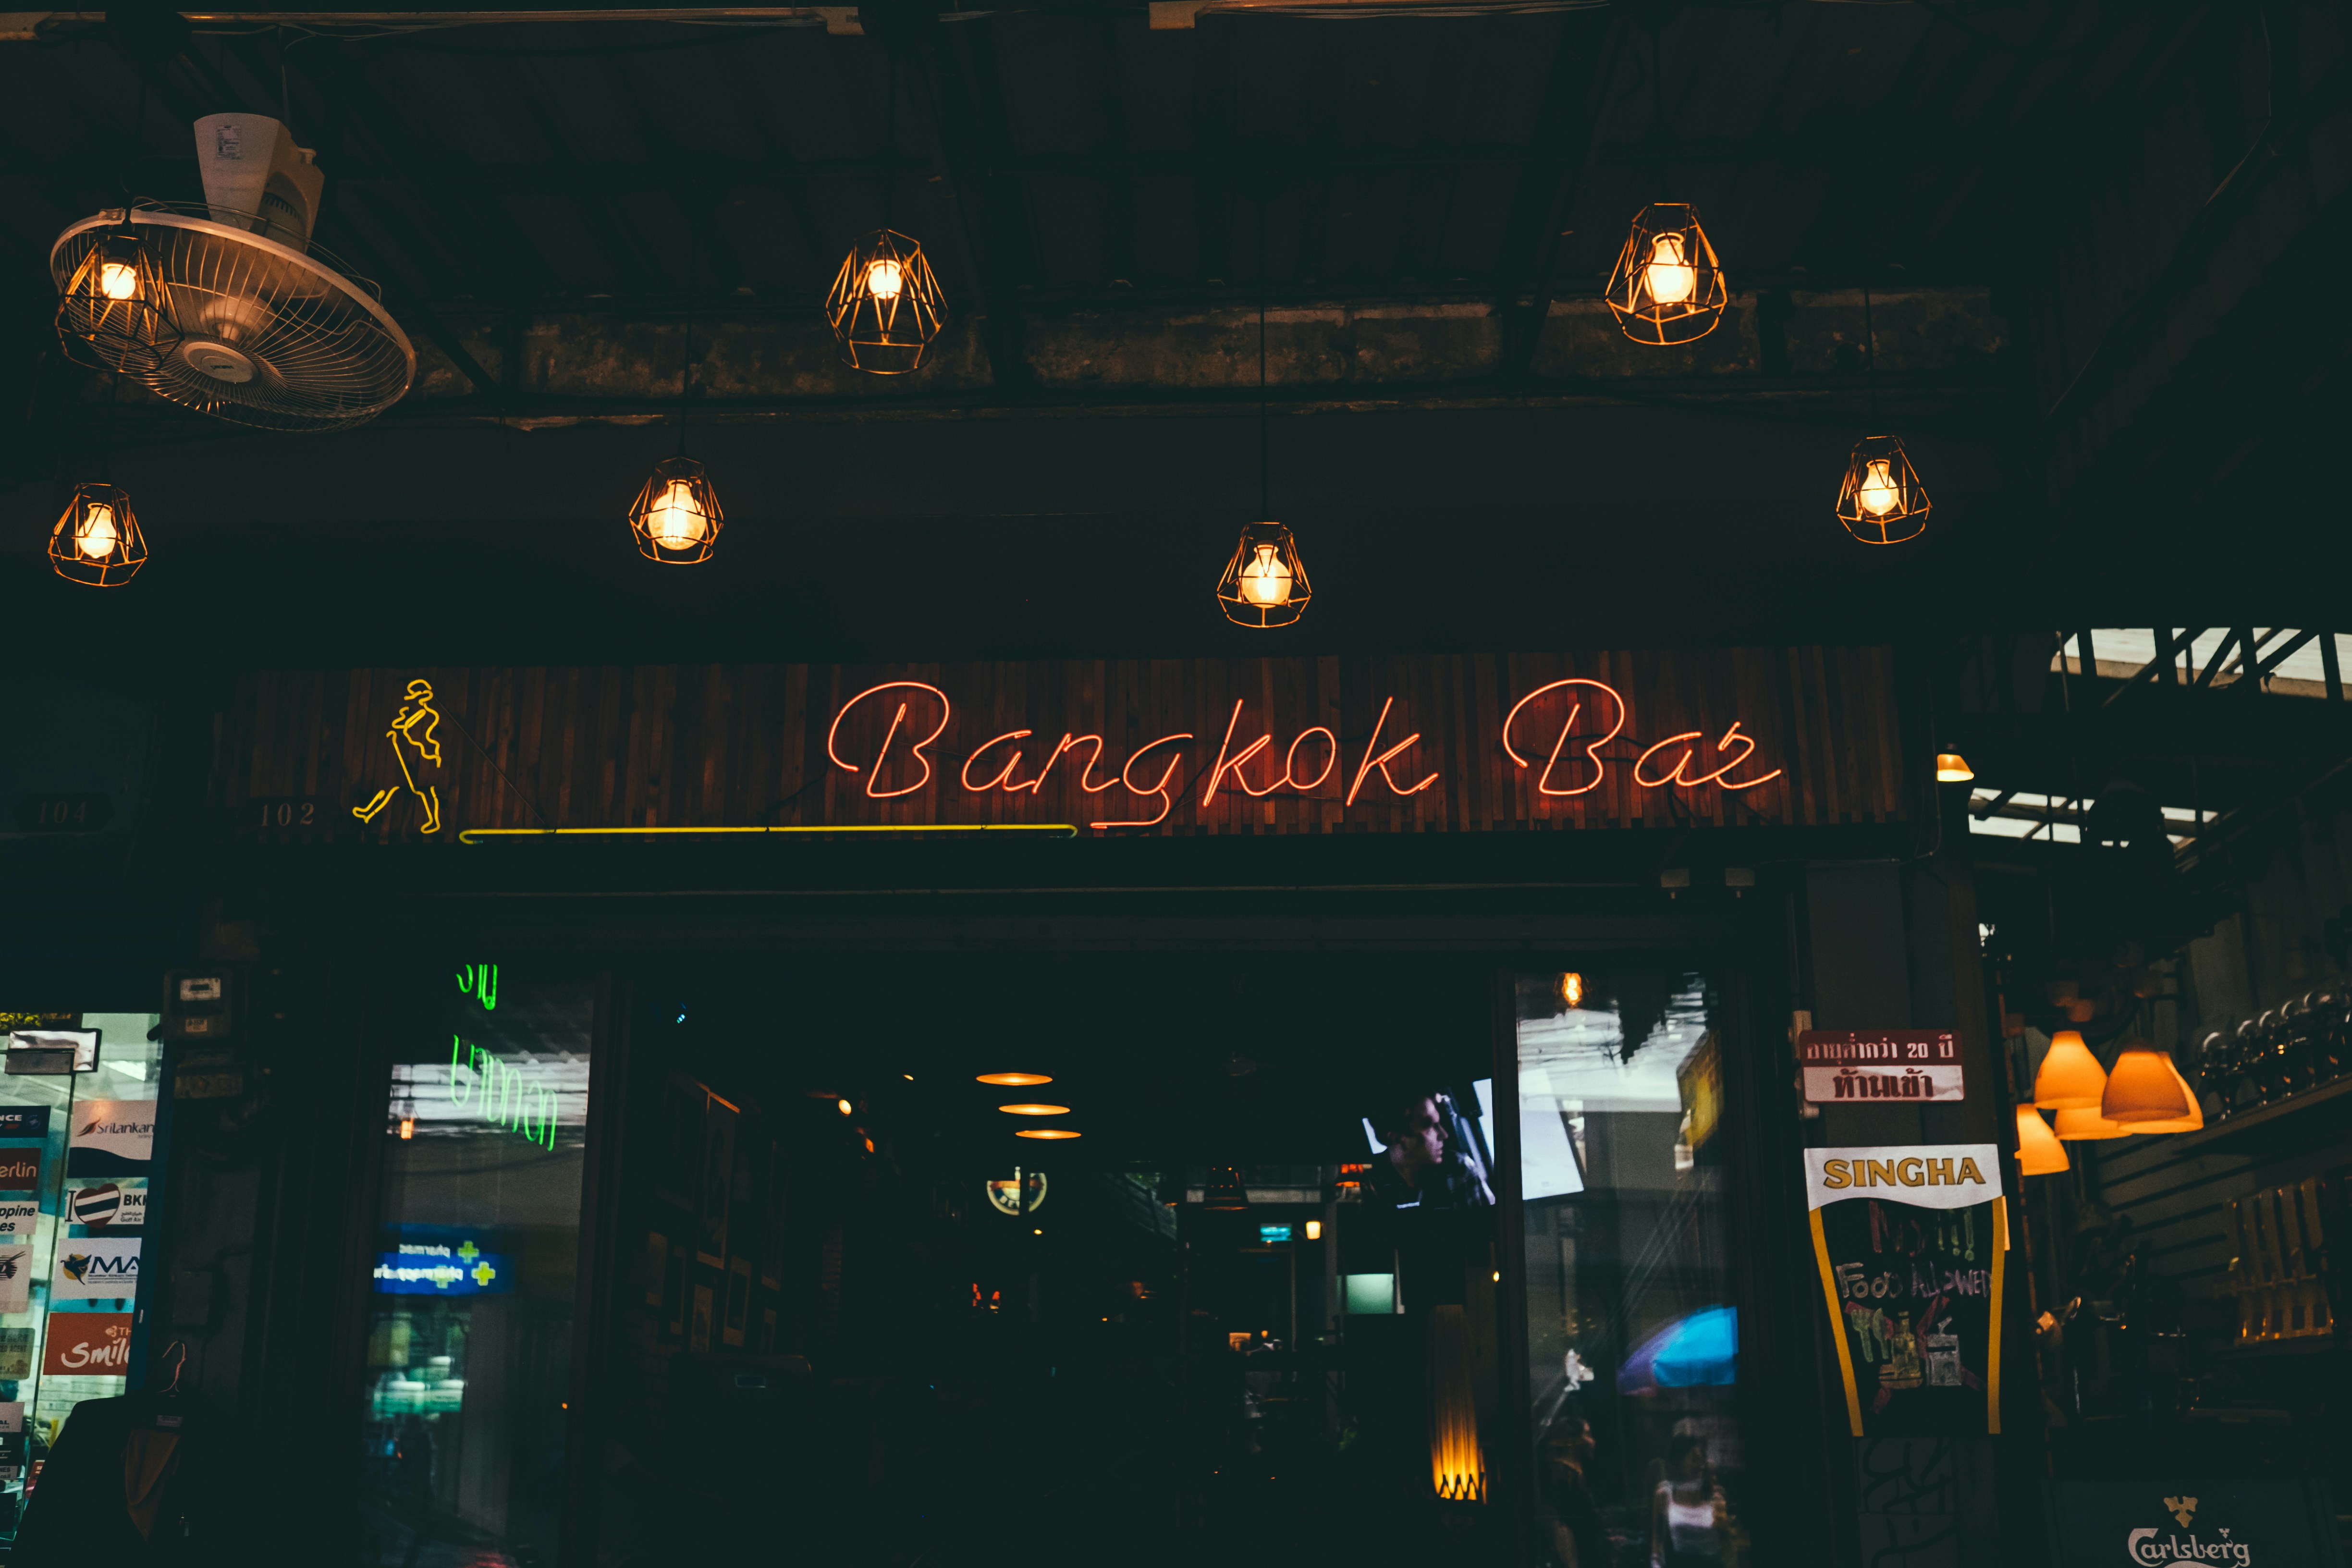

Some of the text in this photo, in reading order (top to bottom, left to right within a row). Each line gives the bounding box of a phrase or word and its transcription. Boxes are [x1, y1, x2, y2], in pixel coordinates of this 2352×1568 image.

[828, 678, 1781, 829] Bangkok Bar
[38, 801, 86, 823] 104
[261, 802, 315, 827] 102
[1907, 1043, 1928, 1058] 20
[1938, 1034, 1954, 1057] ปี
[1833, 1068, 1934, 1098] ห้ามเข้า
[97, 1122, 154, 1134] SriLankan
[1824, 1157, 1986, 1189] SINGHA
[2128, 1528, 2250, 1567] Carlsberg
